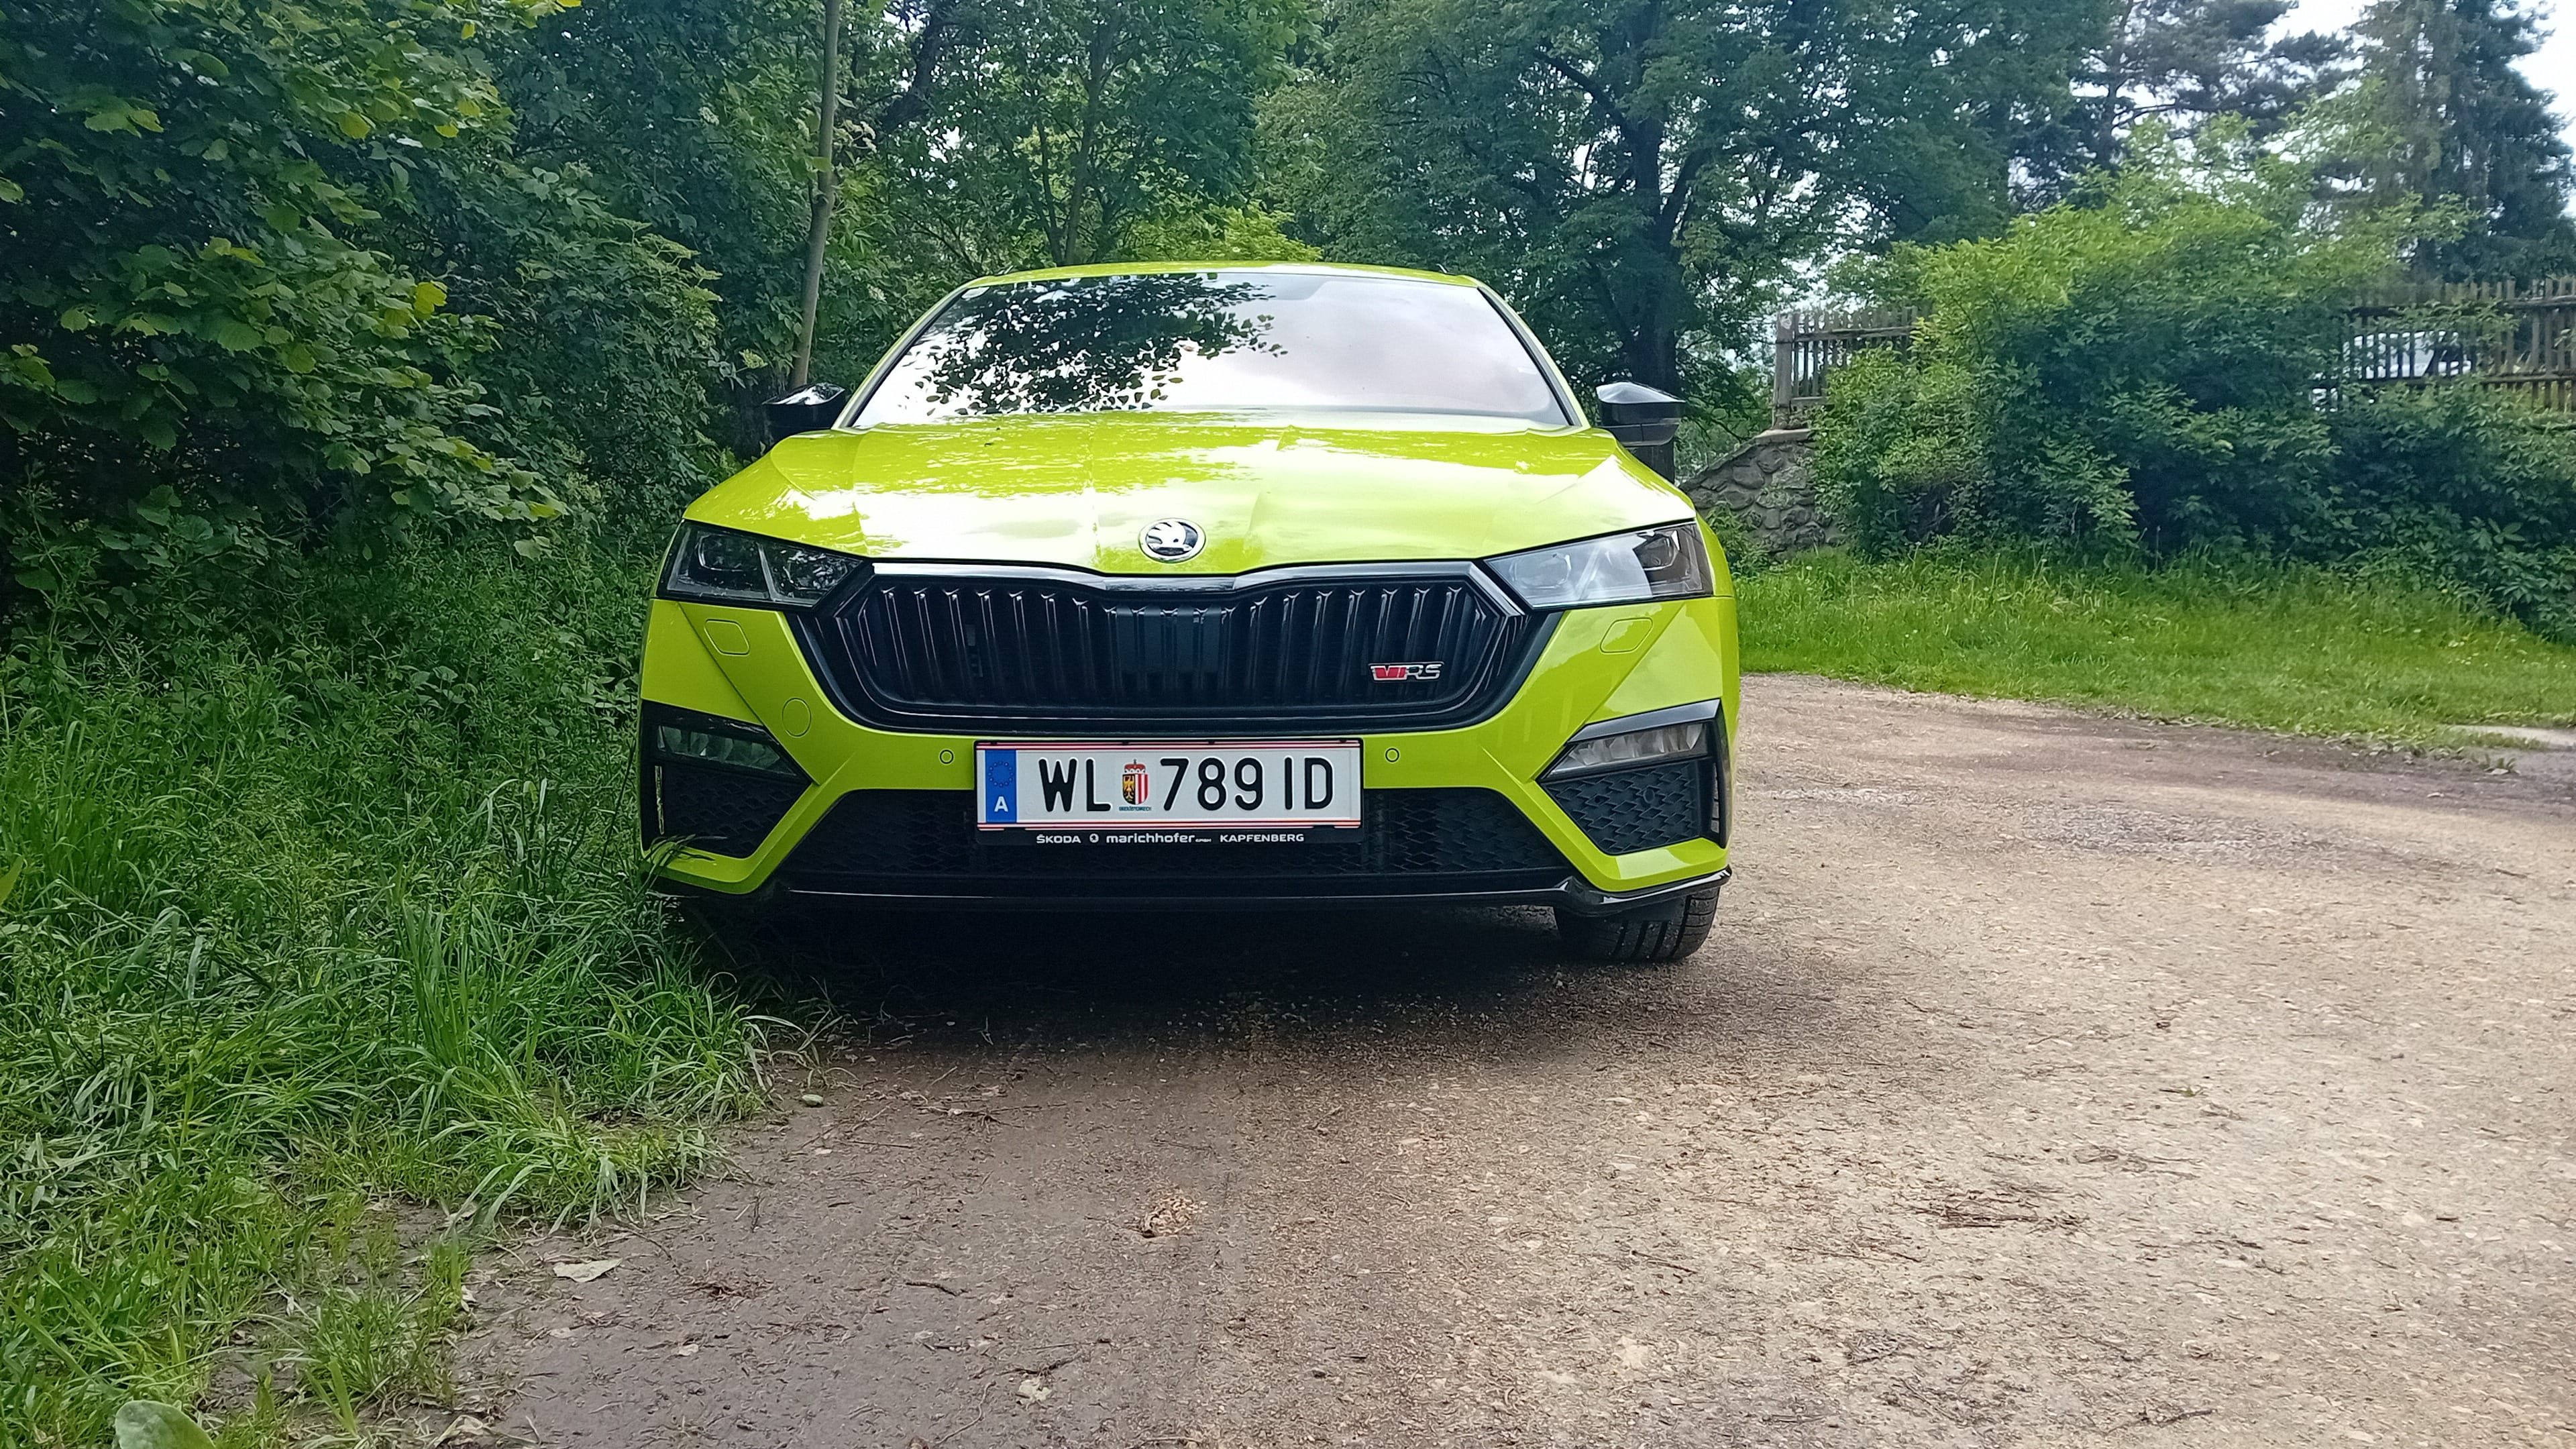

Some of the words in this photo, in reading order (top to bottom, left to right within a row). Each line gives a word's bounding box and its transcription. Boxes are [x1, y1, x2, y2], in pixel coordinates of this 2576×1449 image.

[1038, 758, 1112, 812] WL
[1160, 757, 1263, 811] 789
[1284, 757, 1334, 810] ID
[994, 796, 1009, 812] A
[1036, 834, 1081, 844] ŠKODA
[1106, 833, 1195, 843] marichhofer
[1220, 834, 1305, 843] KAPFENBERG
